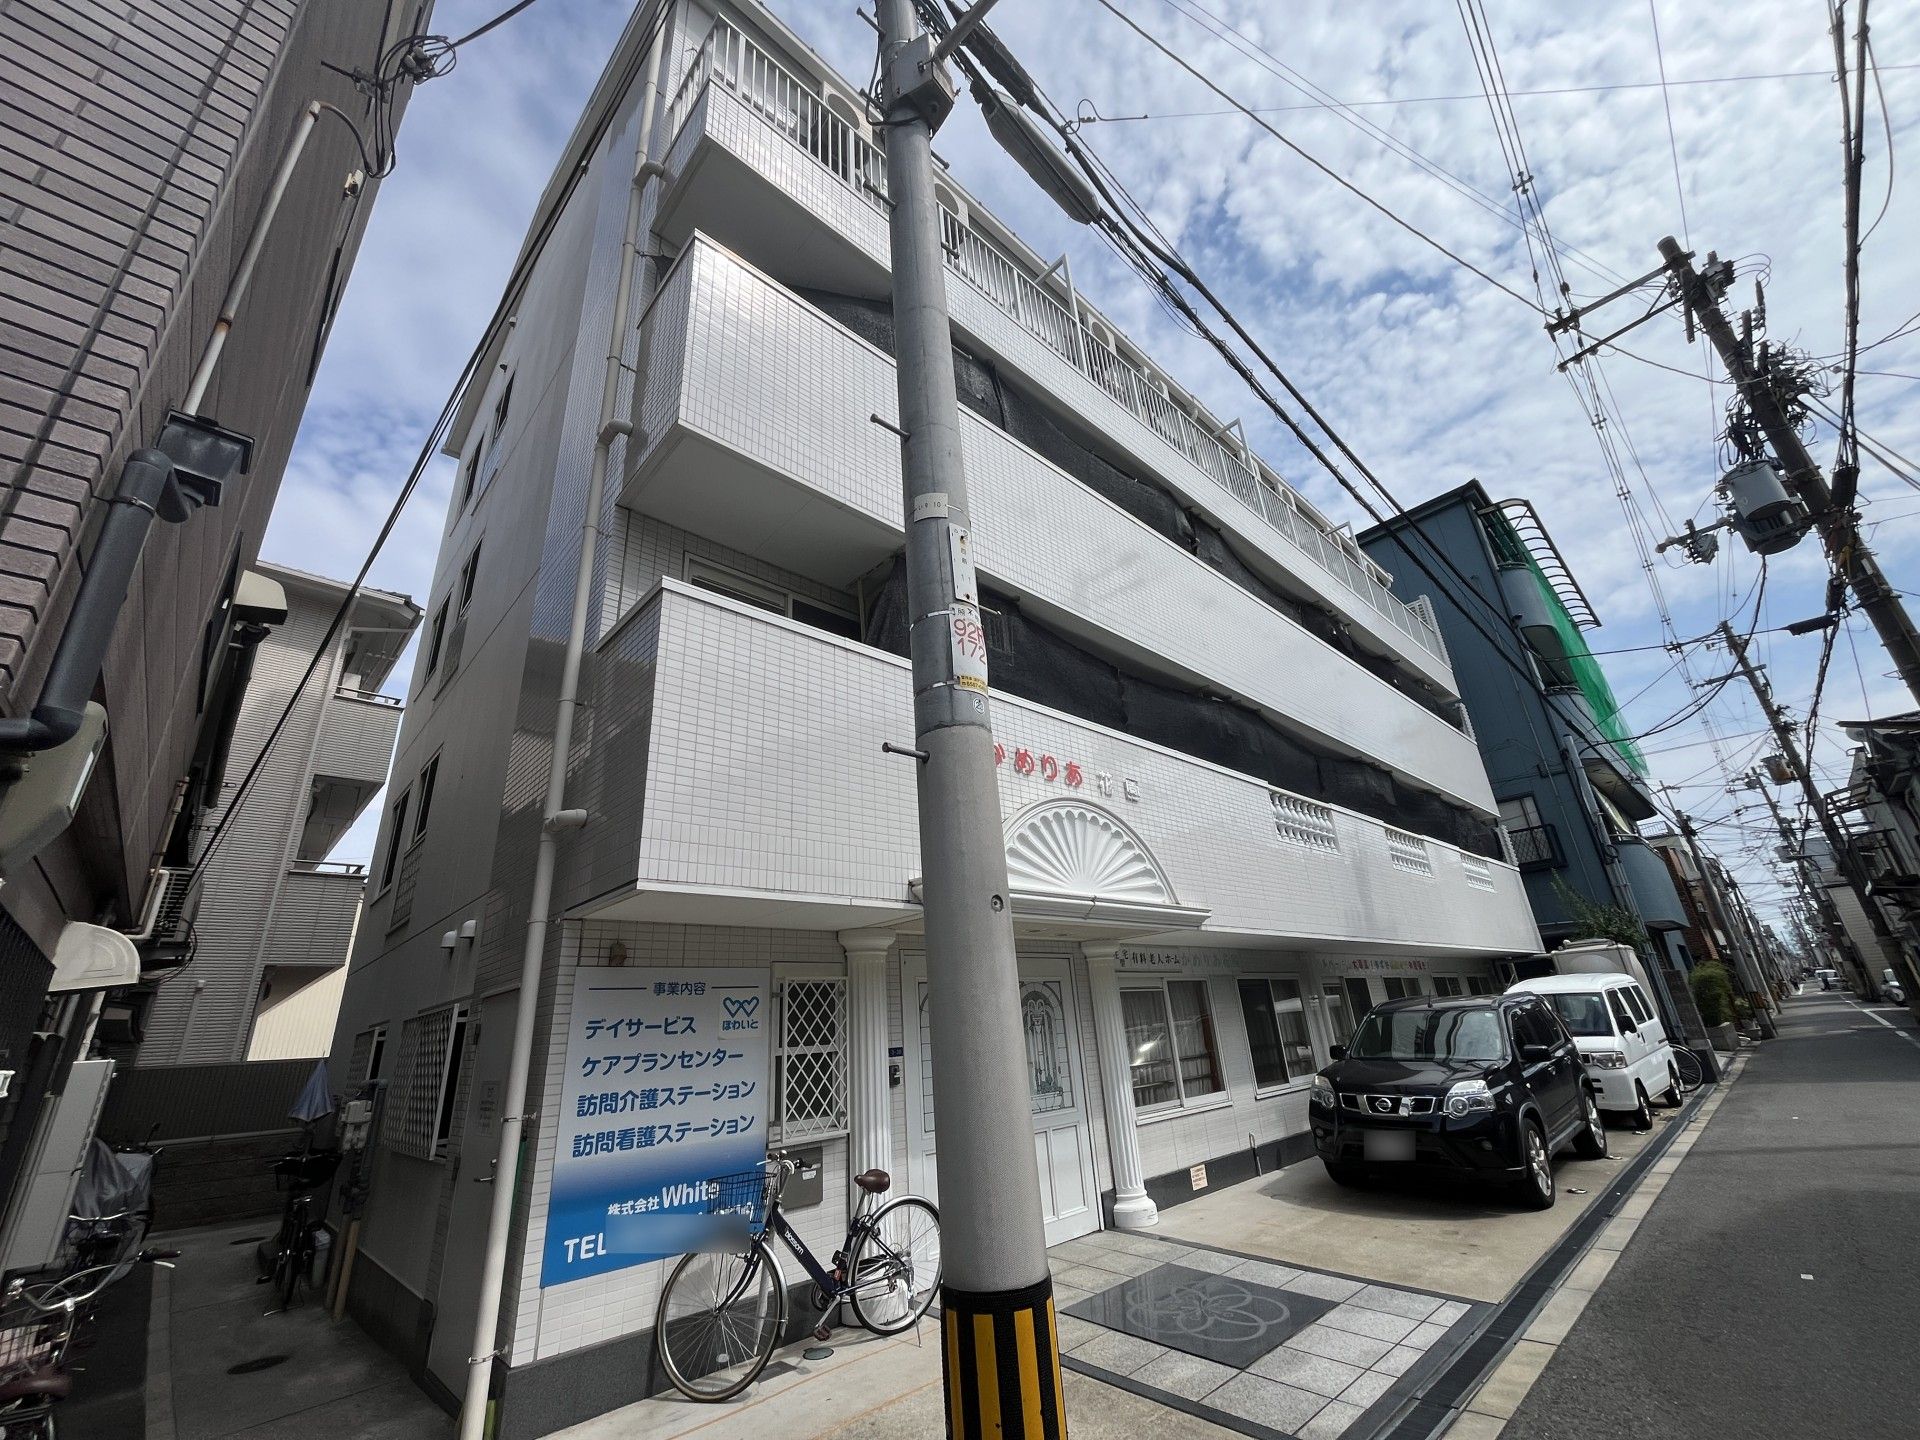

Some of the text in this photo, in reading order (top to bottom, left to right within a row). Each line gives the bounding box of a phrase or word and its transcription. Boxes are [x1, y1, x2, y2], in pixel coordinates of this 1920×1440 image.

[652, 981, 706, 996] 事業内容
[585, 1016, 697, 1040] デイサービス
[581, 1048, 744, 1078] ケアプランセンター
[576, 1080, 756, 1118] 訪問介護ステーション
[572, 1115, 755, 1158] 訪問看護ステーション
[607, 1196, 660, 1215] 株式会社
[564, 1232, 607, 1264] TEL
[784, 1229, 804, 1255] blossom
